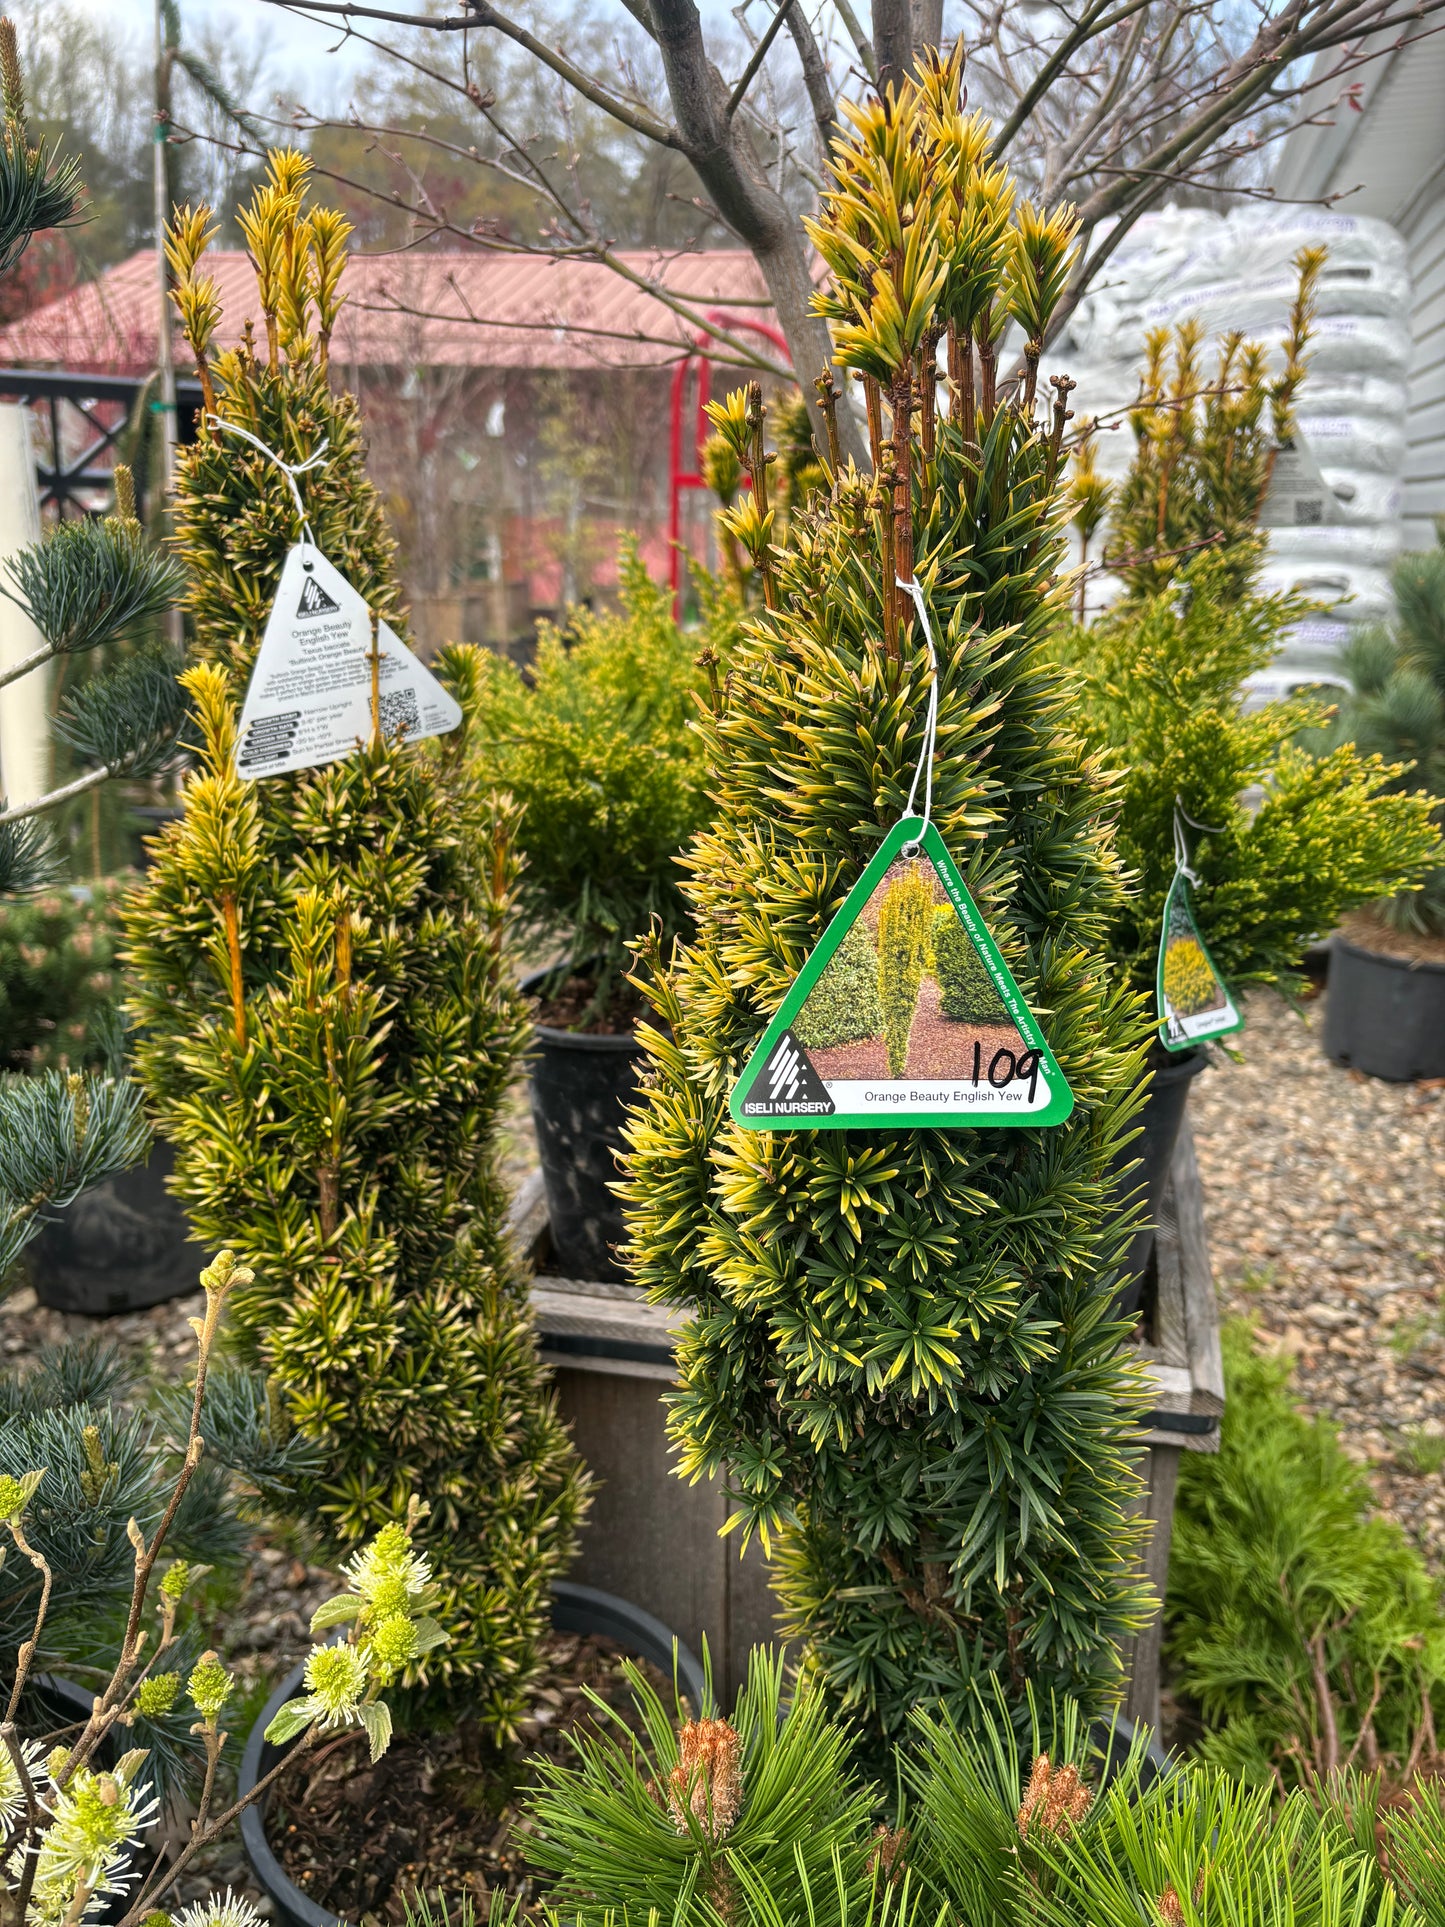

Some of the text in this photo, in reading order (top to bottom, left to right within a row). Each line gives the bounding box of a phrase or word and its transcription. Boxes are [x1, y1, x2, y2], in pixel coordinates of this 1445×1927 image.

[292, 621, 351, 638] Orange Beauty
[300, 631, 349, 646] English Yew
[936, 859, 954, 887] Where
[950, 888, 962, 902] the
[958, 903, 977, 932] Beauty
[973, 933, 984, 942] of
[979, 943, 997, 972] Nature
[994, 972, 1011, 998] Meets
[1008, 998, 1020, 1015] The
[1016, 1015, 1037, 1045] Artistry
[972, 1040, 1044, 1104] 109
[864, 1090, 1022, 1104] Orange Beauty English Yew
[745, 1101, 831, 1114] ISELI NURSERY
